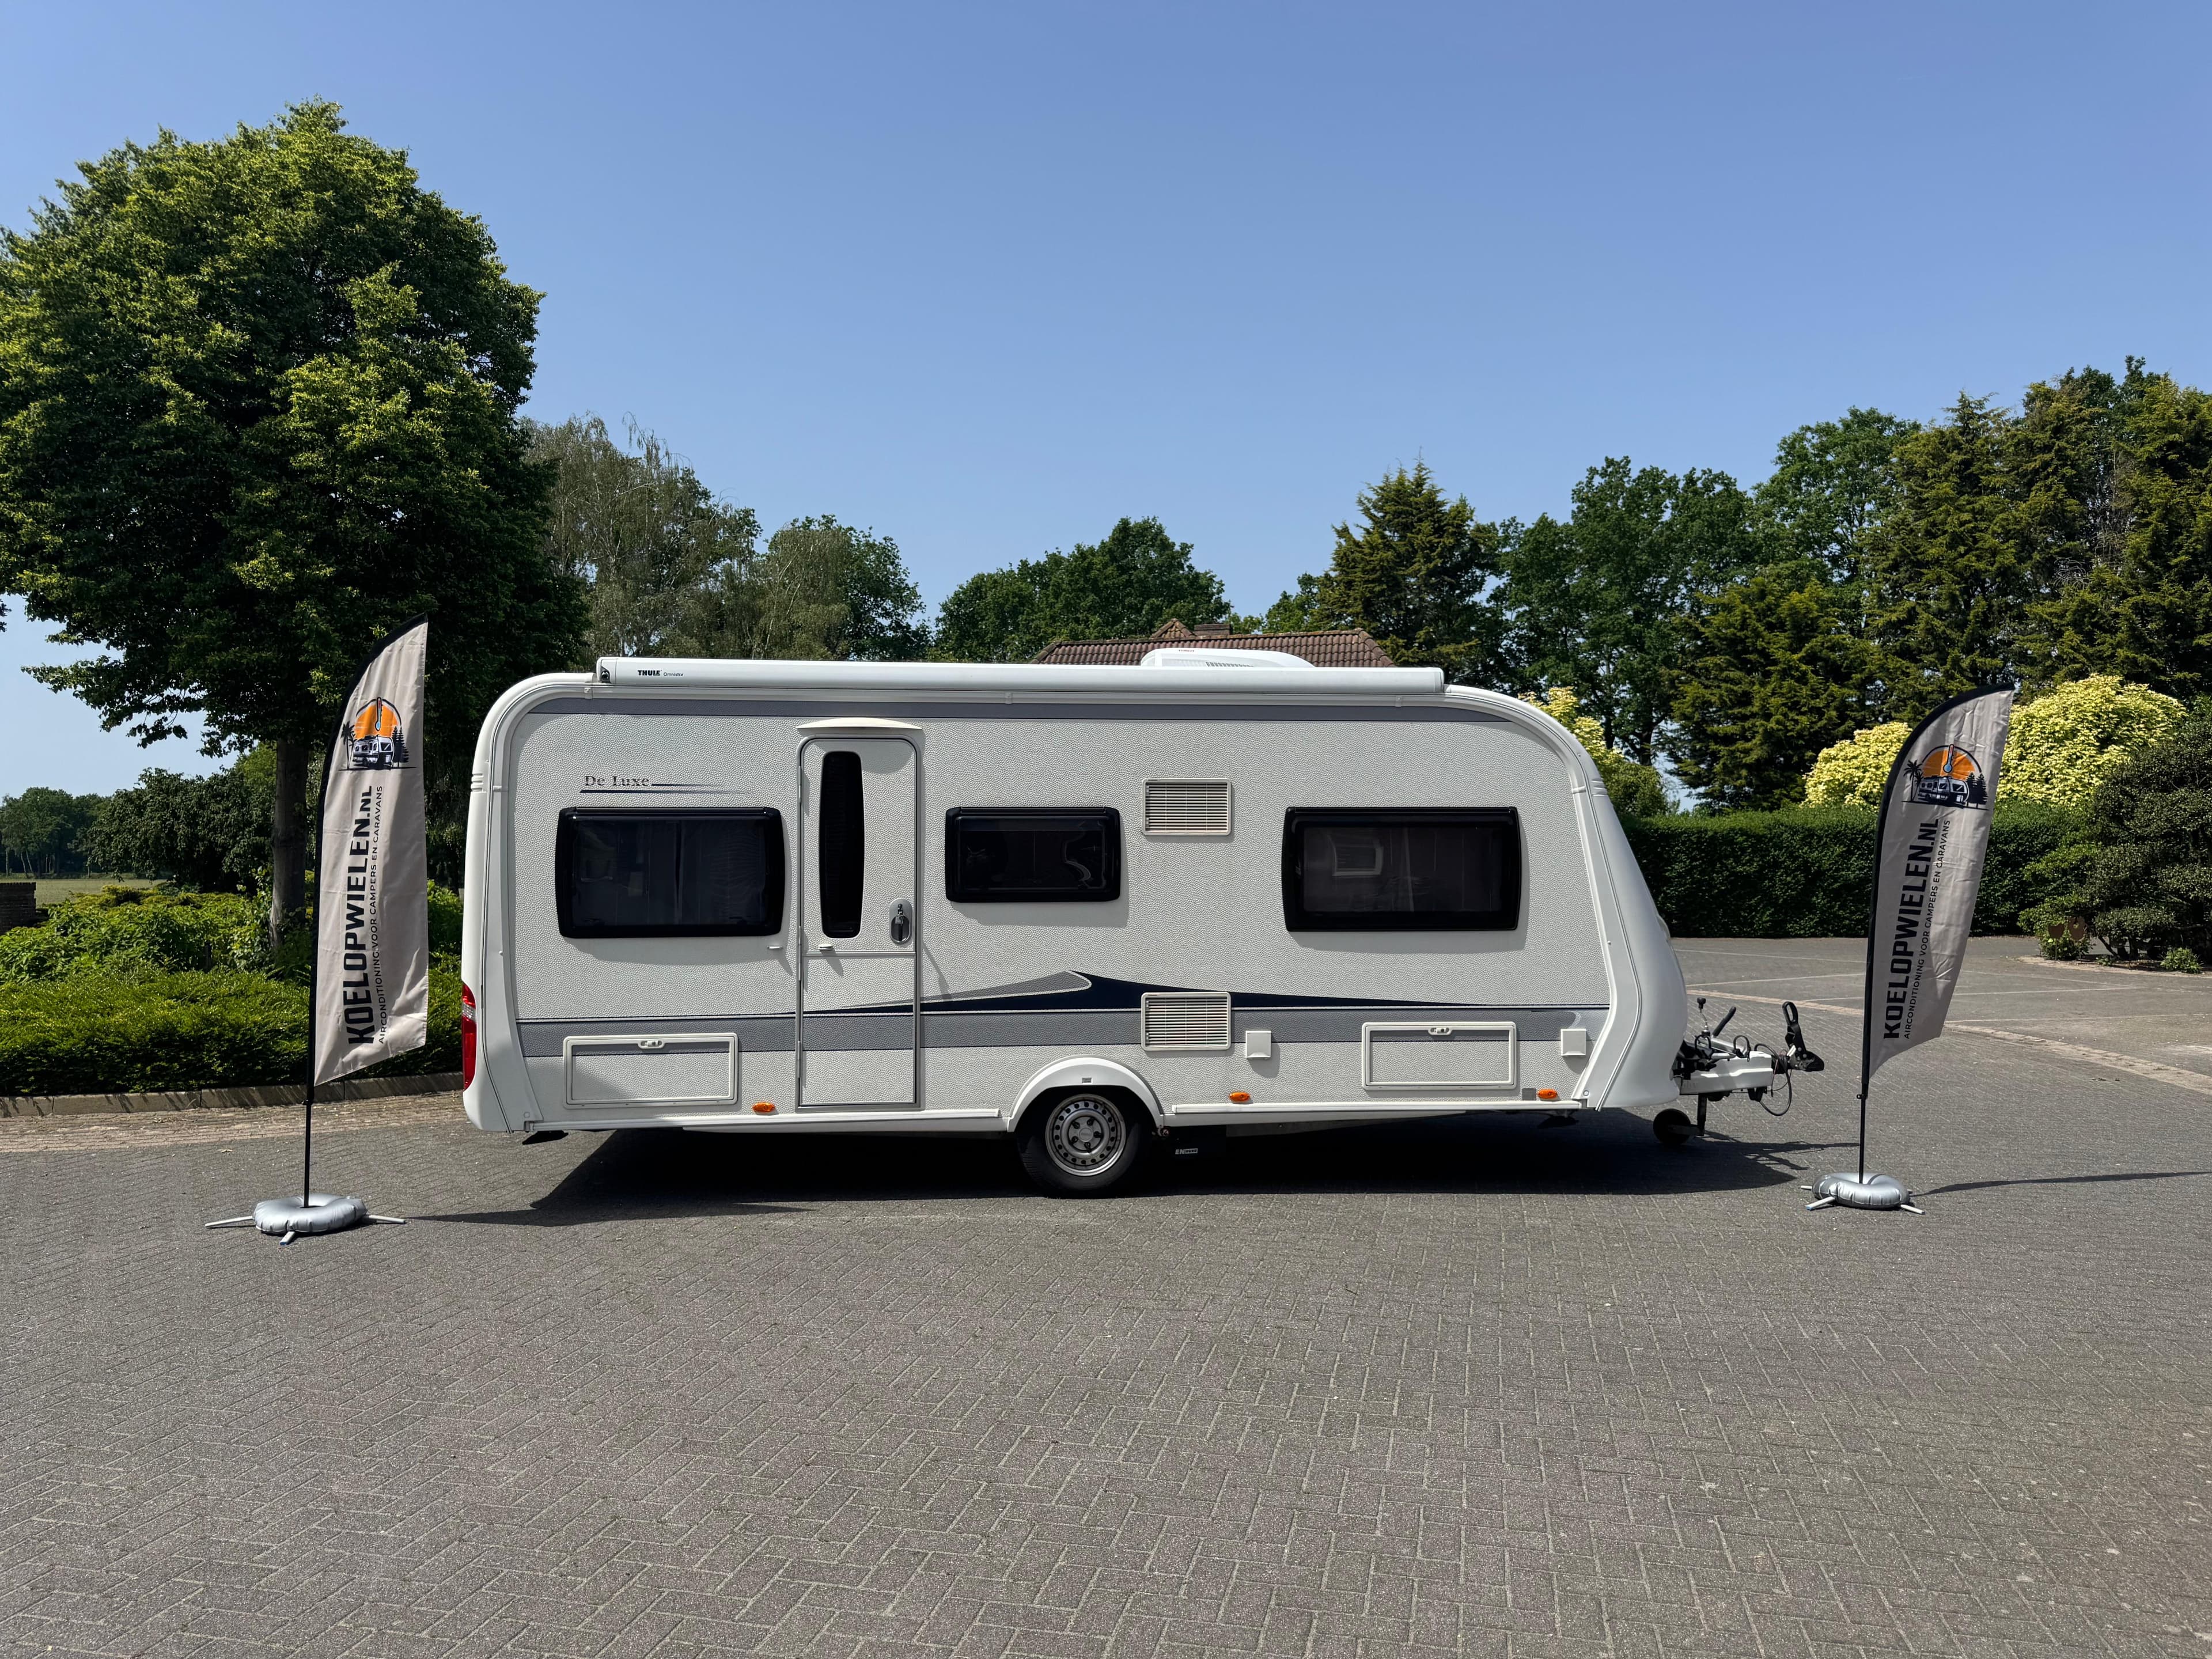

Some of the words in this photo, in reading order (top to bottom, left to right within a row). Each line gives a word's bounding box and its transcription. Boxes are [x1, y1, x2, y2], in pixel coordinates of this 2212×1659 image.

[585, 775, 605, 786] De
[612, 775, 649, 786] Luxe
[373, 786, 382, 843] CARAVANS
[372, 847, 378, 861] EN
[1936, 820, 1950, 868] CARAVANS
[1933, 871, 1941, 883] EN
[343, 786, 375, 1044] KOELOPWIELEN.NL
[1883, 819, 1939, 1039] KOELOPWIELEN.NL
[1925, 885, 1938, 928] CAMPERS
[370, 918, 378, 949] VOOR
[1919, 931, 1930, 956] VOOR
[372, 951, 387, 1044] AIRCONDITIONING
[1903, 959, 1925, 1039] AIRCONDITIONING
